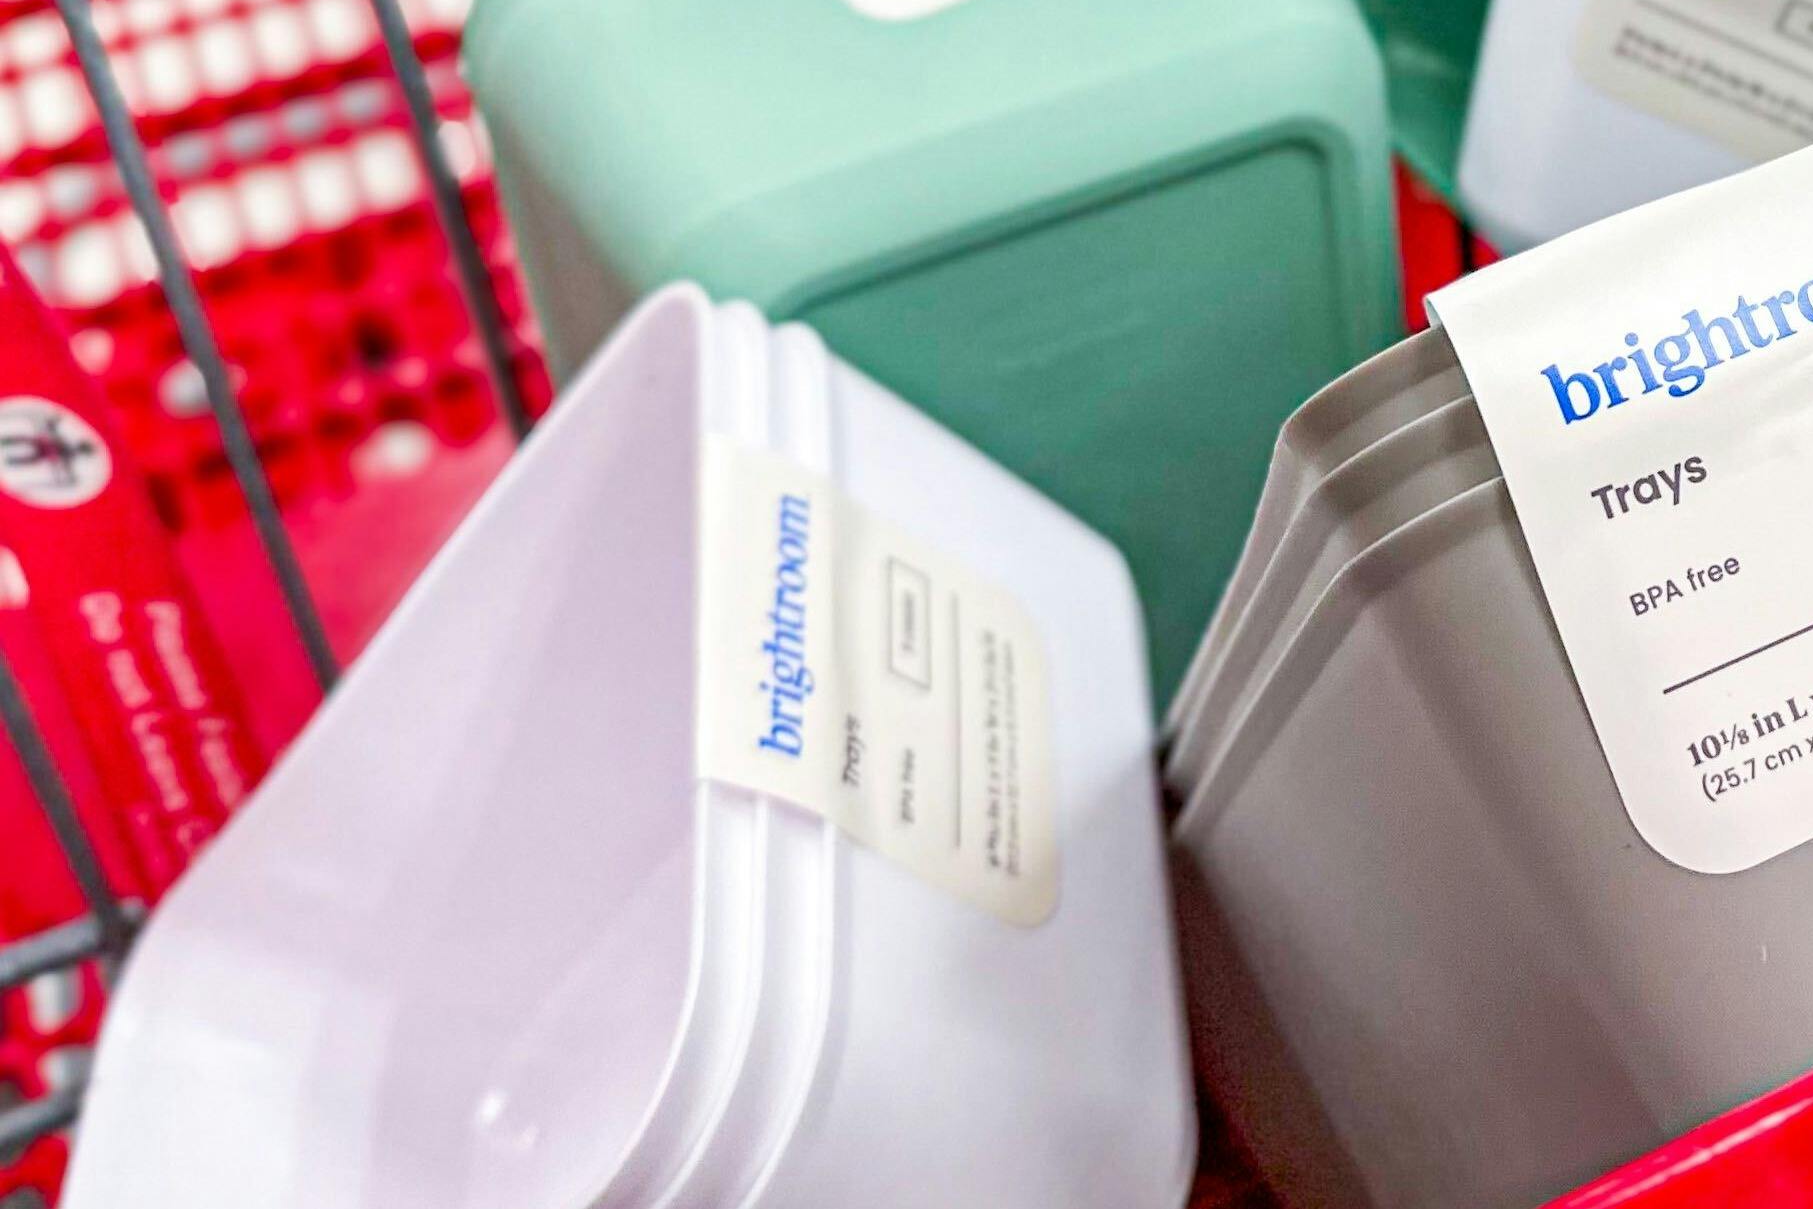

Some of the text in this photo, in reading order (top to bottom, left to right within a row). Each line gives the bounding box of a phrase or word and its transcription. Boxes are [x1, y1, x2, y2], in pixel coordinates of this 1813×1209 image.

[1591, 455, 1708, 520] Trays
[1628, 557, 1742, 617] BPA free
[756, 493, 816, 758] brightroom
[1751, 709, 1786, 740] in
[1785, 693, 1811, 722] L
[1700, 758, 1758, 803] (25.7
[1763, 743, 1804, 771] cm
